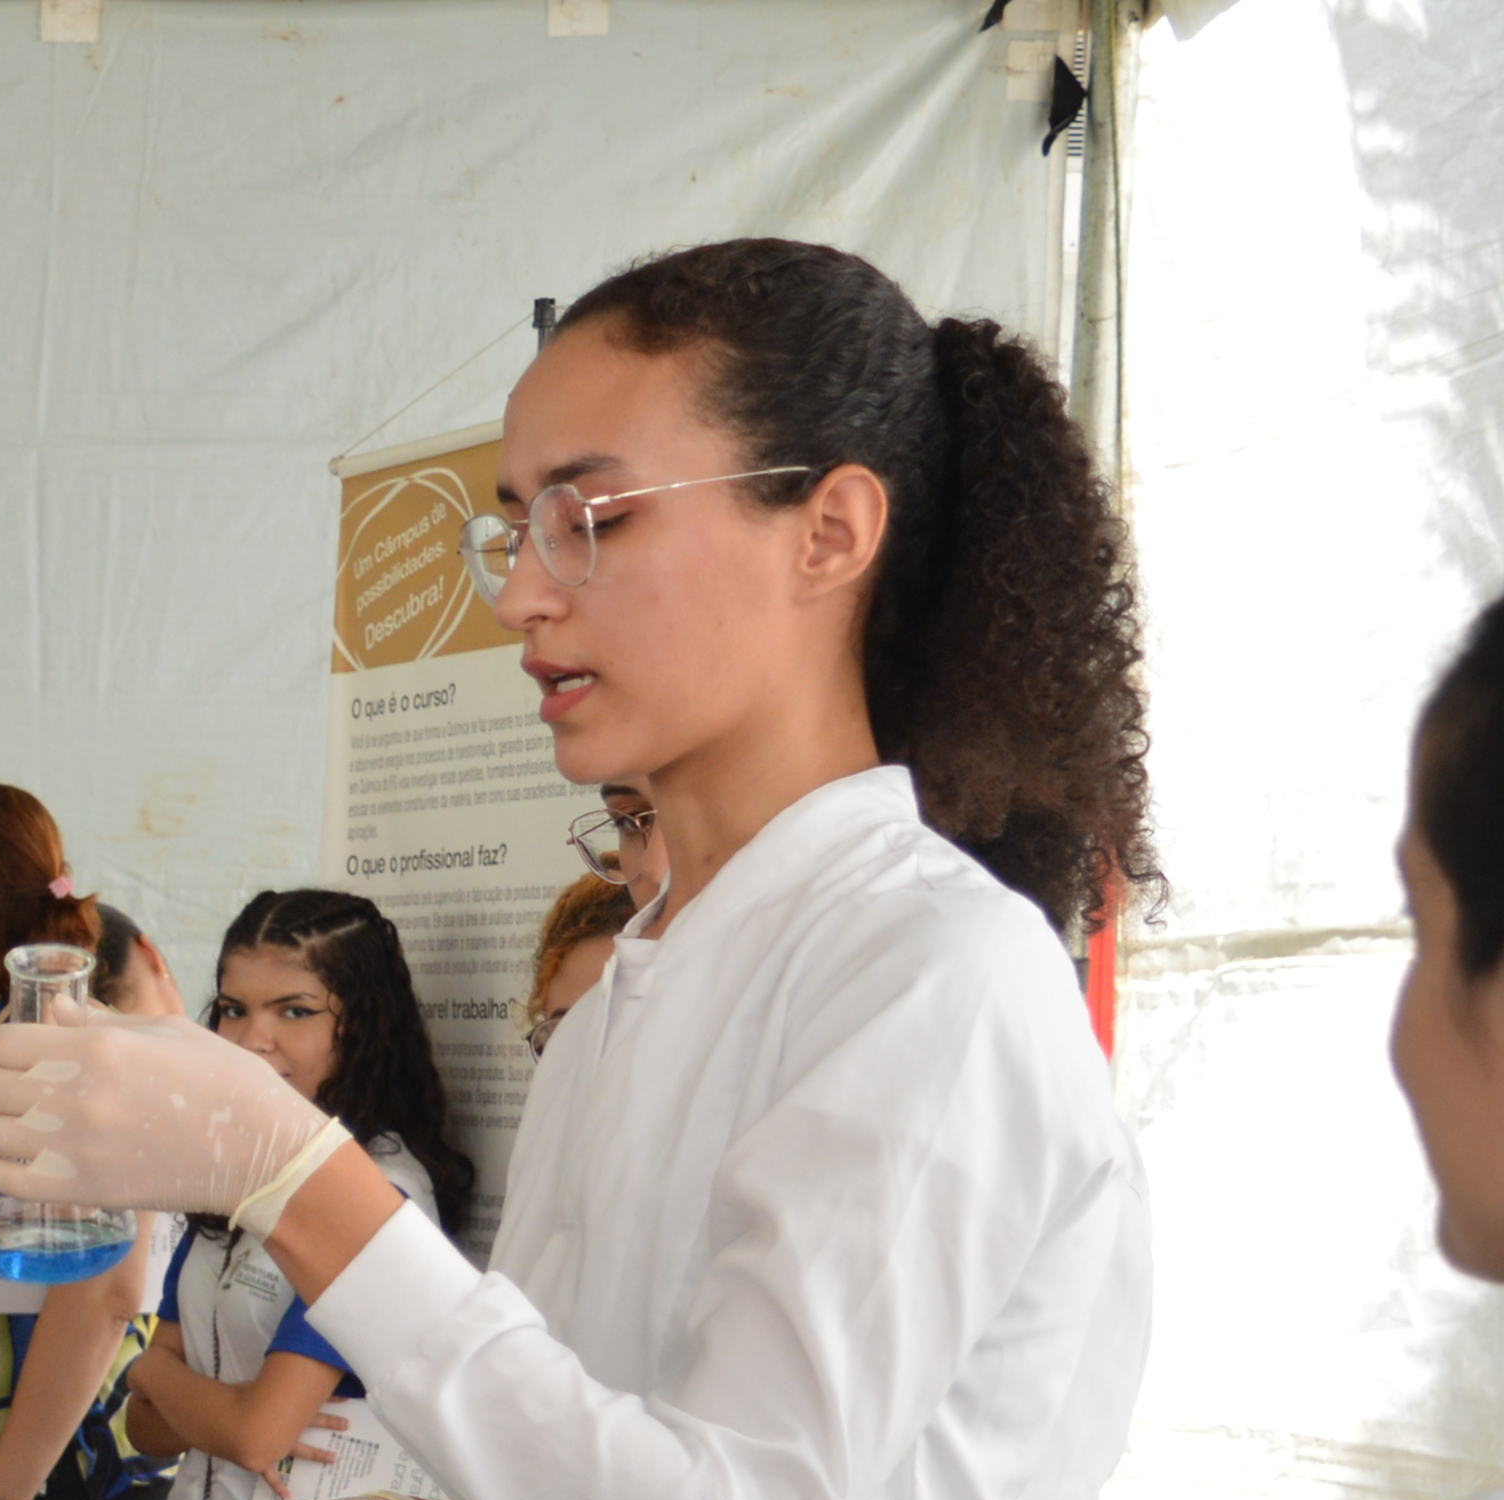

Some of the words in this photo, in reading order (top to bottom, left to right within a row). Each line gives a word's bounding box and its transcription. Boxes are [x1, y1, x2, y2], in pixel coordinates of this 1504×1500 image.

[353, 554, 373, 580] Um
[374, 516, 430, 563] Câmpus
[431, 502, 447, 525] de
[355, 541, 447, 618] possibilidades.
[365, 575, 444, 651] Descubra!
[352, 698, 362, 719] O
[365, 698, 386, 722] que
[389, 691, 397, 713] é
[401, 695, 410, 712] o
[413, 682, 457, 711] curso?
[346, 854, 359, 875] O
[362, 857, 386, 879] que
[390, 857, 398, 873] o
[400, 845, 474, 877] profissional
[478, 842, 508, 867] faz?
[452, 996, 516, 1020] trabalha?
